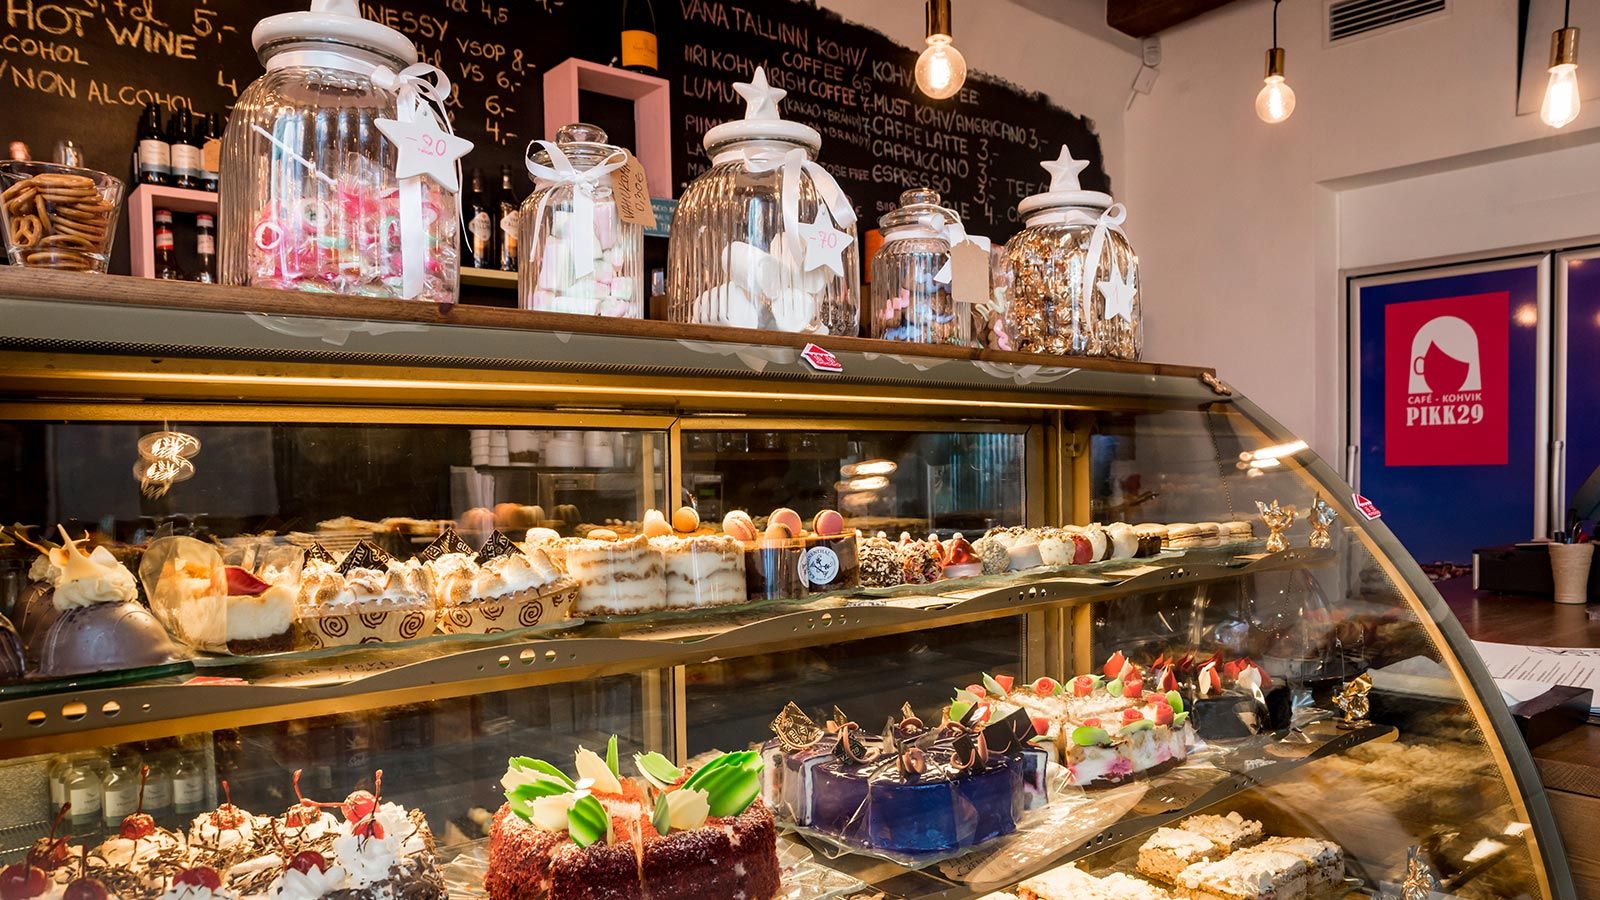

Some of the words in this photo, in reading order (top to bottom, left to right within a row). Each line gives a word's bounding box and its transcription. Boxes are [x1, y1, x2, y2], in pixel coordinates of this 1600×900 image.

[7, 0, 94, 38] HOT
[105, 18, 198, 60] WINE
[361, 3, 449, 41] NESSY
[680, 0, 730, 29] VANA
[731, 6, 809, 52] TALLINN
[0, 33, 89, 66] COHOL
[456, 37, 506, 62] VSOP
[459, 62, 485, 82] VS
[684, 44, 707, 67] IIRI
[808, 78, 857, 107] COFFEE
[782, 51, 846, 82] COFFEE
[88, 79, 206, 118] ALCOHOL
[874, 93, 912, 117] MUST
[872, 115, 922, 146] CAFFE
[925, 126, 970, 155] LATTE
[872, 139, 969, 179] CAPPUCCINO
[872, 164, 951, 193] ESPRESSO
[1442, 392, 1482, 404] KOHVIK
[1406, 403, 1484, 427] PIKK29
